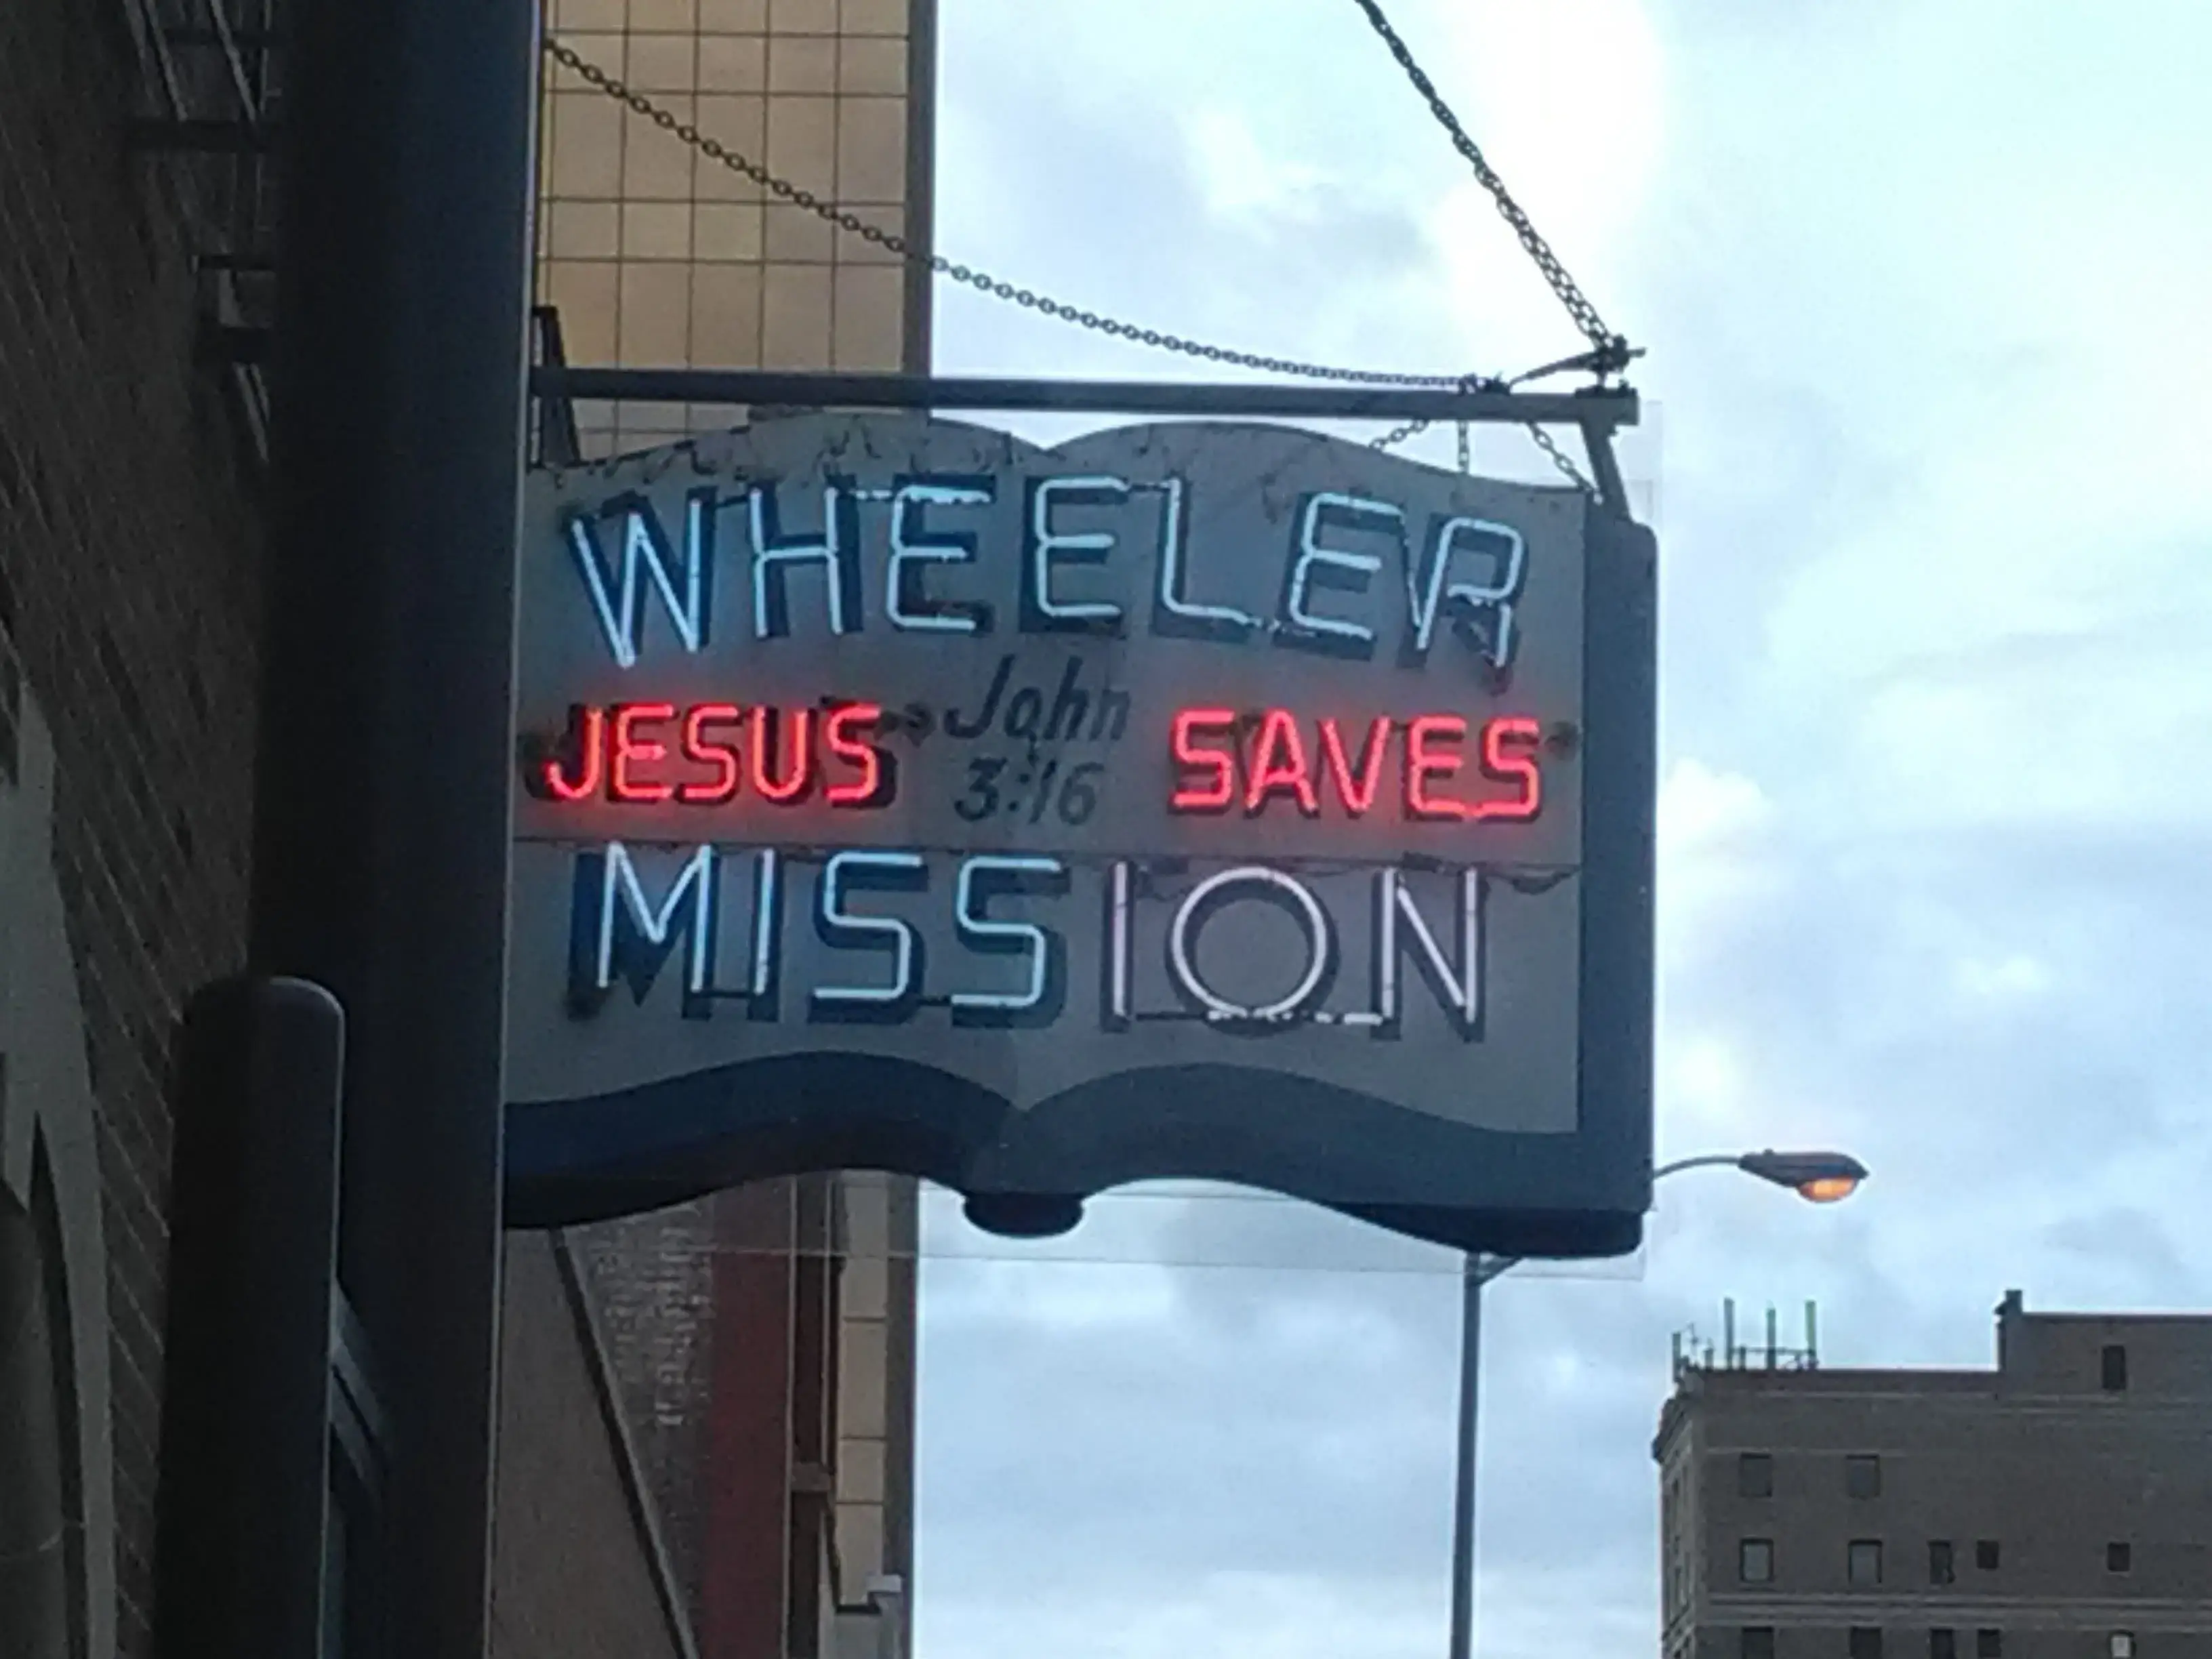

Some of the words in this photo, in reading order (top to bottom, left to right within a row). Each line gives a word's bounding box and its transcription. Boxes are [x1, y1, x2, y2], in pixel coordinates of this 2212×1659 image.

[568, 476, 1528, 671] WHEELER
[944, 653, 1130, 740] John
[541, 702, 889, 804] JESUS
[1170, 706, 1542, 819] SAVES
[954, 756, 1105, 825] 3:16
[584, 842, 1487, 1037] MISSION
